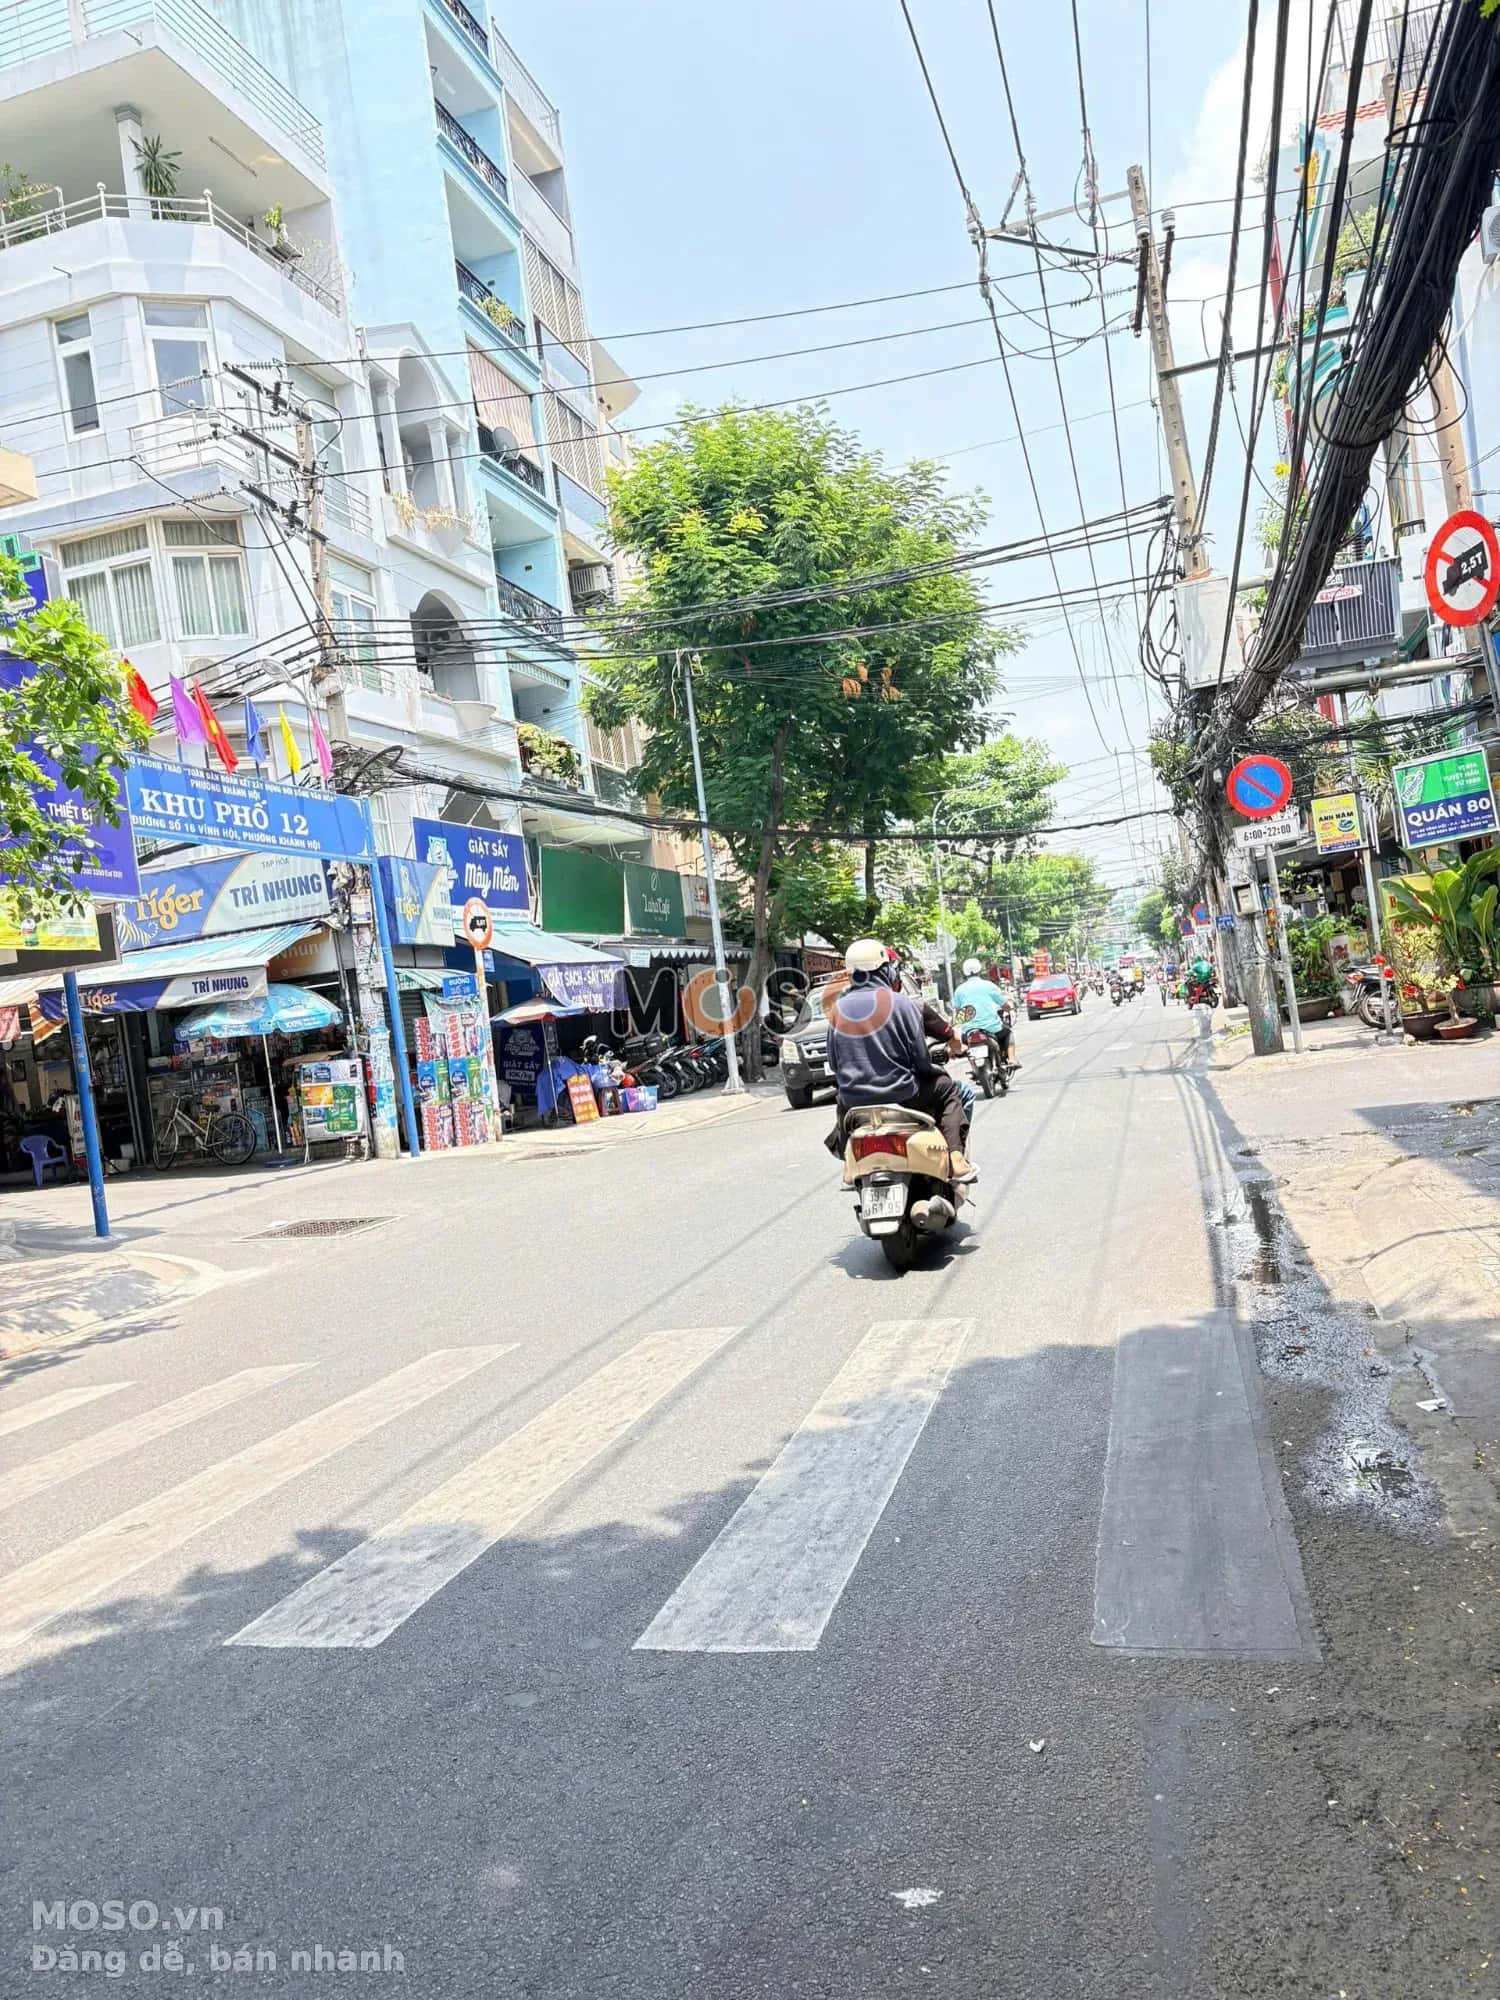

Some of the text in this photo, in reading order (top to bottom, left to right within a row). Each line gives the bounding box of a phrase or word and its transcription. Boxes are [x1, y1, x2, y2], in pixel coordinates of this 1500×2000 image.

[1460, 552, 1482, 575] 2,5T
[47, 799, 79, 820] THIẾT
[139, 787, 309, 836] KHU PHỐ 12
[1407, 797, 1491, 827] QUÁN 80
[131, 814, 167, 829] ĐƯỜNG
[168, 818, 182, 831] SỐ
[198, 823, 221, 837] VĨNH
[279, 834, 306, 848] KHÁNH
[307, 838, 321, 850] HỘI
[1243, 823, 1291, 841] 6:00-22:00
[468, 837, 509, 860] GIẶT SẤY
[230, 873, 322, 909] TRÍ NHUNG
[464, 863, 491, 899] Mây
[492, 864, 520, 893] Mềm
[136, 883, 204, 931] Tiger
[79, 986, 118, 1009] Tiger
[192, 974, 250, 995] TRÍ NHUNG
